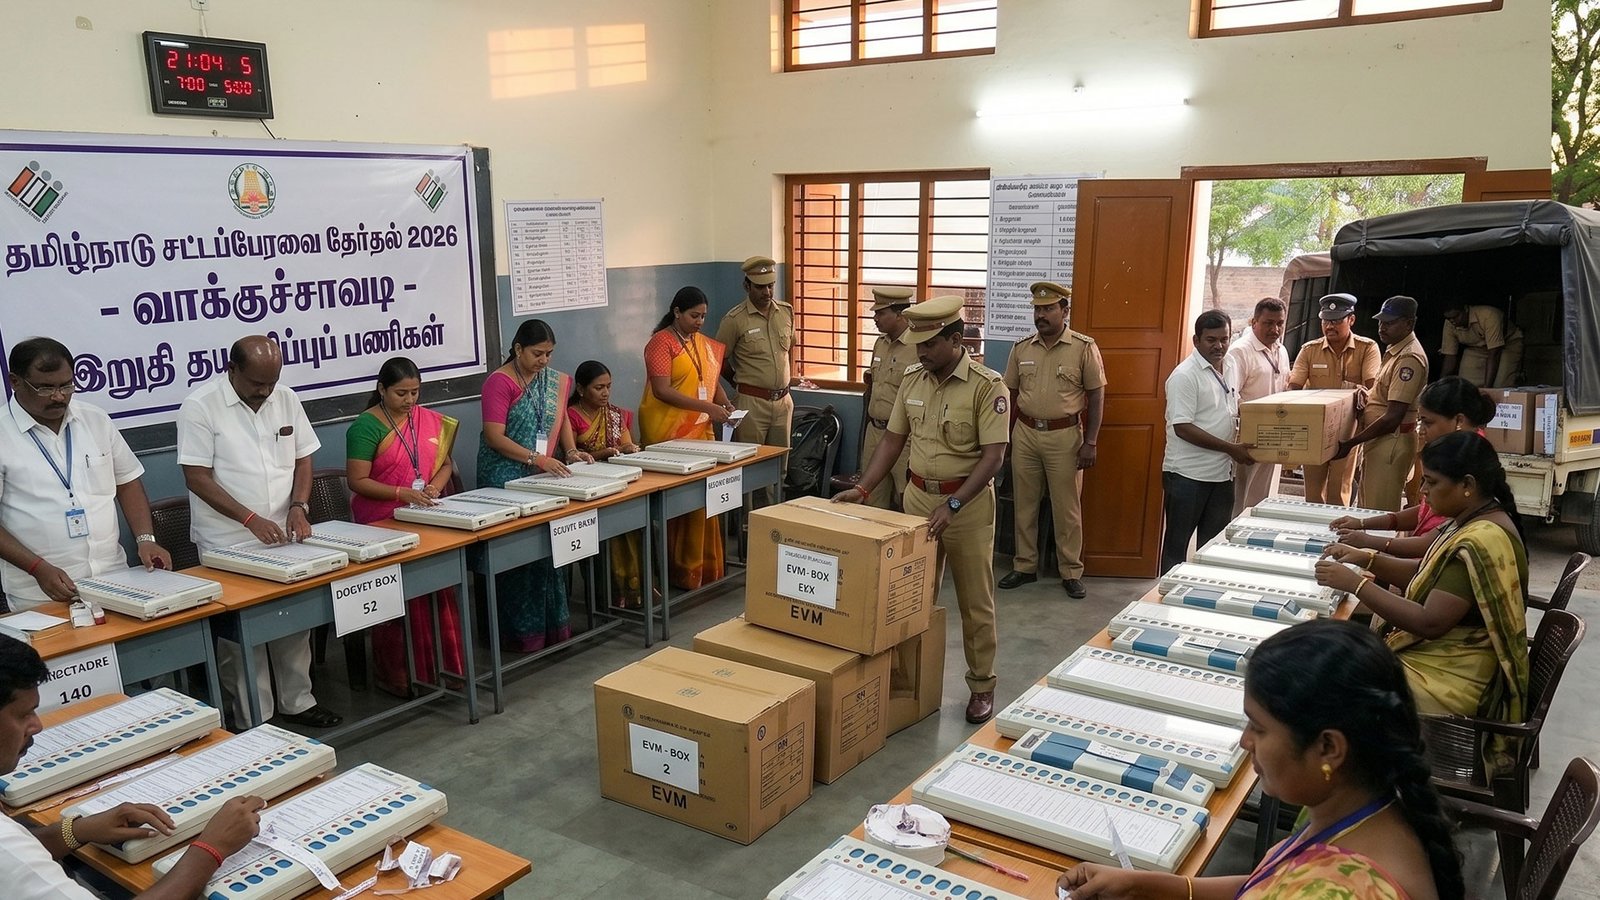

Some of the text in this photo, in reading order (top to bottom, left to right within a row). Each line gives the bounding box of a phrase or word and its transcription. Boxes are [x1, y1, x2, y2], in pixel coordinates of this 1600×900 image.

[167, 50, 224, 71] 21:04
[176, 76, 205, 92] 7:00
[5, 221, 458, 278] தமிழ்நாடு சட்டப்பேரவை தேர்தல் 2026
[133, 267, 395, 326] வாக்குச்சாவடி
[74, 341, 176, 400] இறுதி
[345, 313, 445, 358] பணிகள்
[570, 538, 582, 552] 52
[375, 574, 398, 588] BOX
[786, 564, 806, 577] EVM
[811, 569, 830, 582] BOX
[363, 600, 378, 615] 52
[791, 604, 823, 626] EVM
[59, 684, 92, 705] 140
[642, 740, 663, 754] EVM
[670, 748, 690, 762] BOX
[663, 763, 671, 775] 2
[652, 784, 687, 809] EVM
